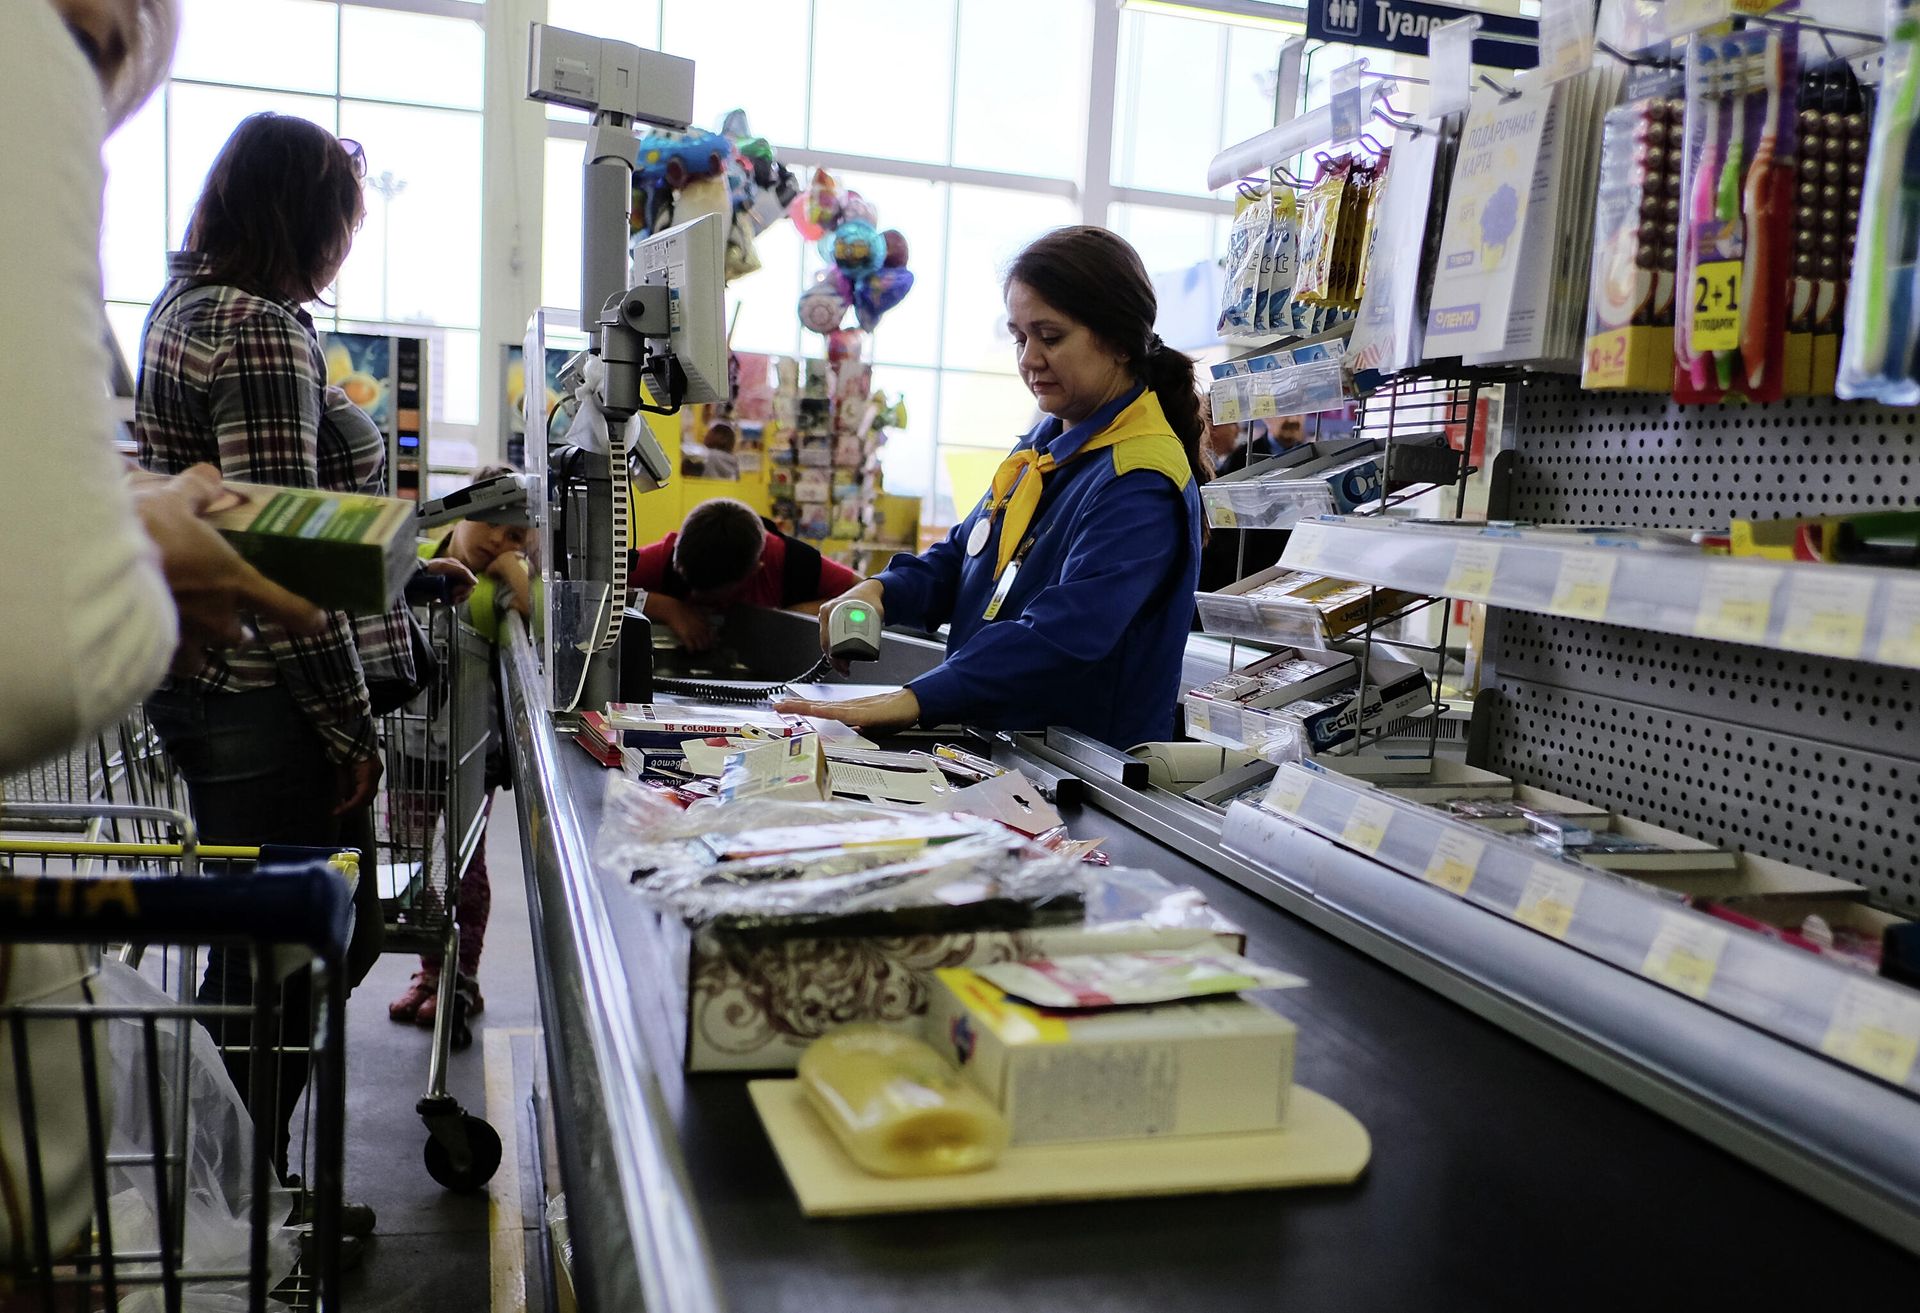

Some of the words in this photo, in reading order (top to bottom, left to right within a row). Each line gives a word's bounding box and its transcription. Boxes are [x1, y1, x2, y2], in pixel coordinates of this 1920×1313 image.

[1376, 1, 1456, 41] Туале
[1467, 110, 1537, 149] ПОДАРОЧНАЯ
[1460, 151, 1493, 178] КАРТА
[1696, 275, 1738, 313] 2+1
[663, 723, 675, 731] 18
[681, 724, 727, 733] COLOURED
[1327, 700, 1383, 734] eclipse
[651, 759, 681, 770] ветов
